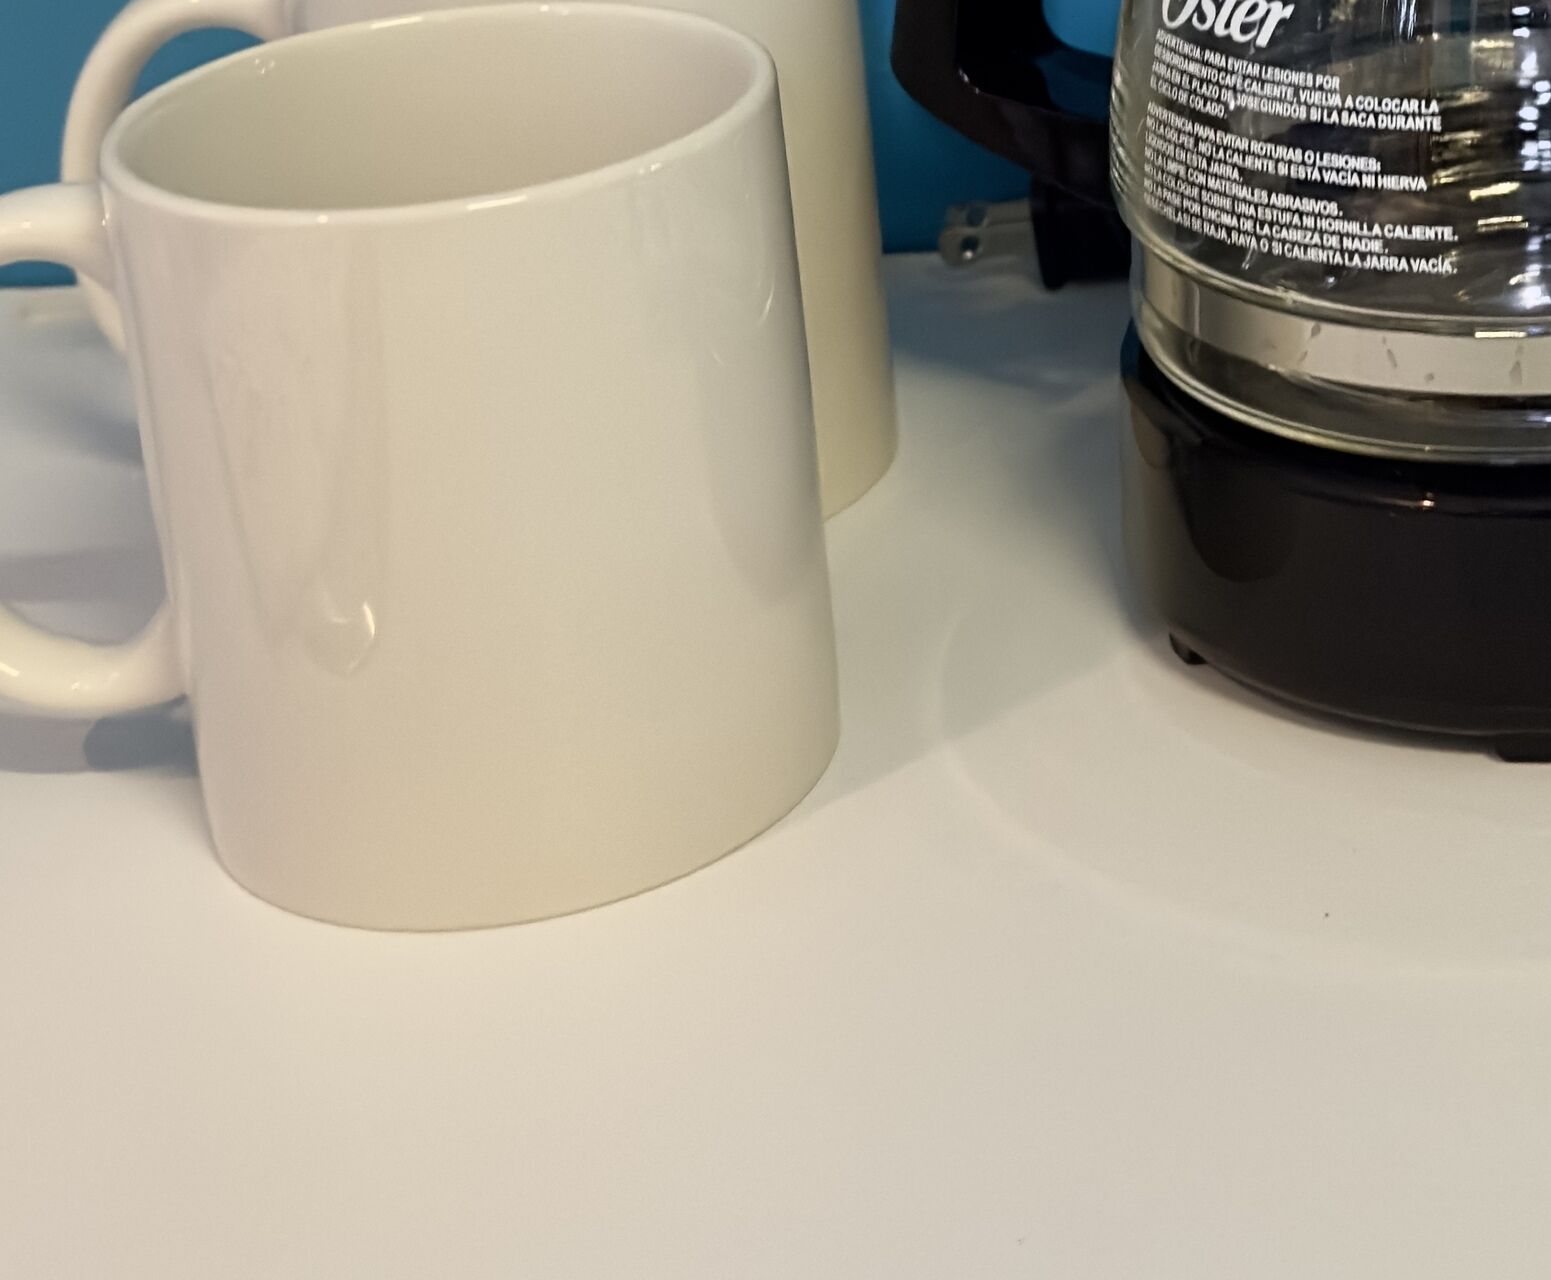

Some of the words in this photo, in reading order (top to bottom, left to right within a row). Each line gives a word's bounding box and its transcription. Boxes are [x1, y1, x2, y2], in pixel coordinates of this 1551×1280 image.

[1204, 49, 1227, 67] PARA
[1228, 56, 1260, 78] EVITAR
[1262, 65, 1313, 88] LESIONES
[1315, 73, 1341, 91] POR
[1191, 77, 1219, 99] PLAZO
[1247, 94, 1306, 120] SEGUNDOS
[1310, 105, 1321, 122] SI
[1323, 108, 1339, 125] LA
[1341, 109, 1376, 128] SACA
[1377, 114, 1441, 132] DURANTE
[1244, 78, 1298, 104] CALIENTE,
[1299, 88, 1342, 108] VUELVA
[1344, 94, 1354, 110] A
[1355, 95, 1419, 114] COLOCAR
[1421, 98, 1439, 114] LA
[1199, 139, 1212, 157] NO
[1213, 145, 1224, 161] LA
[1226, 149, 1276, 174] CALIENTE
[1277, 160, 1288, 176] SI
[1362, 173, 1375, 189] NI
[1378, 175, 1427, 192] HIERVA
[1216, 129, 1249, 154] EVITAR
[1250, 139, 1302, 163] ROTURAS
[1304, 150, 1314, 165] O
[1316, 151, 1381, 173] LESIONES:
[1187, 167, 1206, 187] CON
[1207, 175, 1268, 202] MATERIALES
[1269, 192, 1343, 217] ABRASIVOS.
[1201, 189, 1233, 212] SOBRE
[1234, 200, 1256, 218] UNA
[1257, 206, 1301, 227] ESTUFA
[1303, 213, 1315, 230] NI
[1316, 215, 1382, 237] HORNILLA
[1384, 224, 1458, 241] CALIENTE.
[1182, 197, 1201, 216] POR
[1202, 205, 1239, 228] ENCIMA
[1240, 217, 1255, 233] DE
[1256, 220, 1271, 237] LA
[1272, 224, 1321, 246] CABEZA
[1323, 233, 1340, 249] DE
[1342, 235, 1388, 254] NADIE.
[1231, 229, 1258, 251] RAYA
[1260, 237, 1269, 253] O
[1271, 240, 1282, 256] SI
[1284, 243, 1343, 265] CALIENTA
[1344, 252, 1362, 268] LA
[1363, 253, 1408, 271] JARRA
